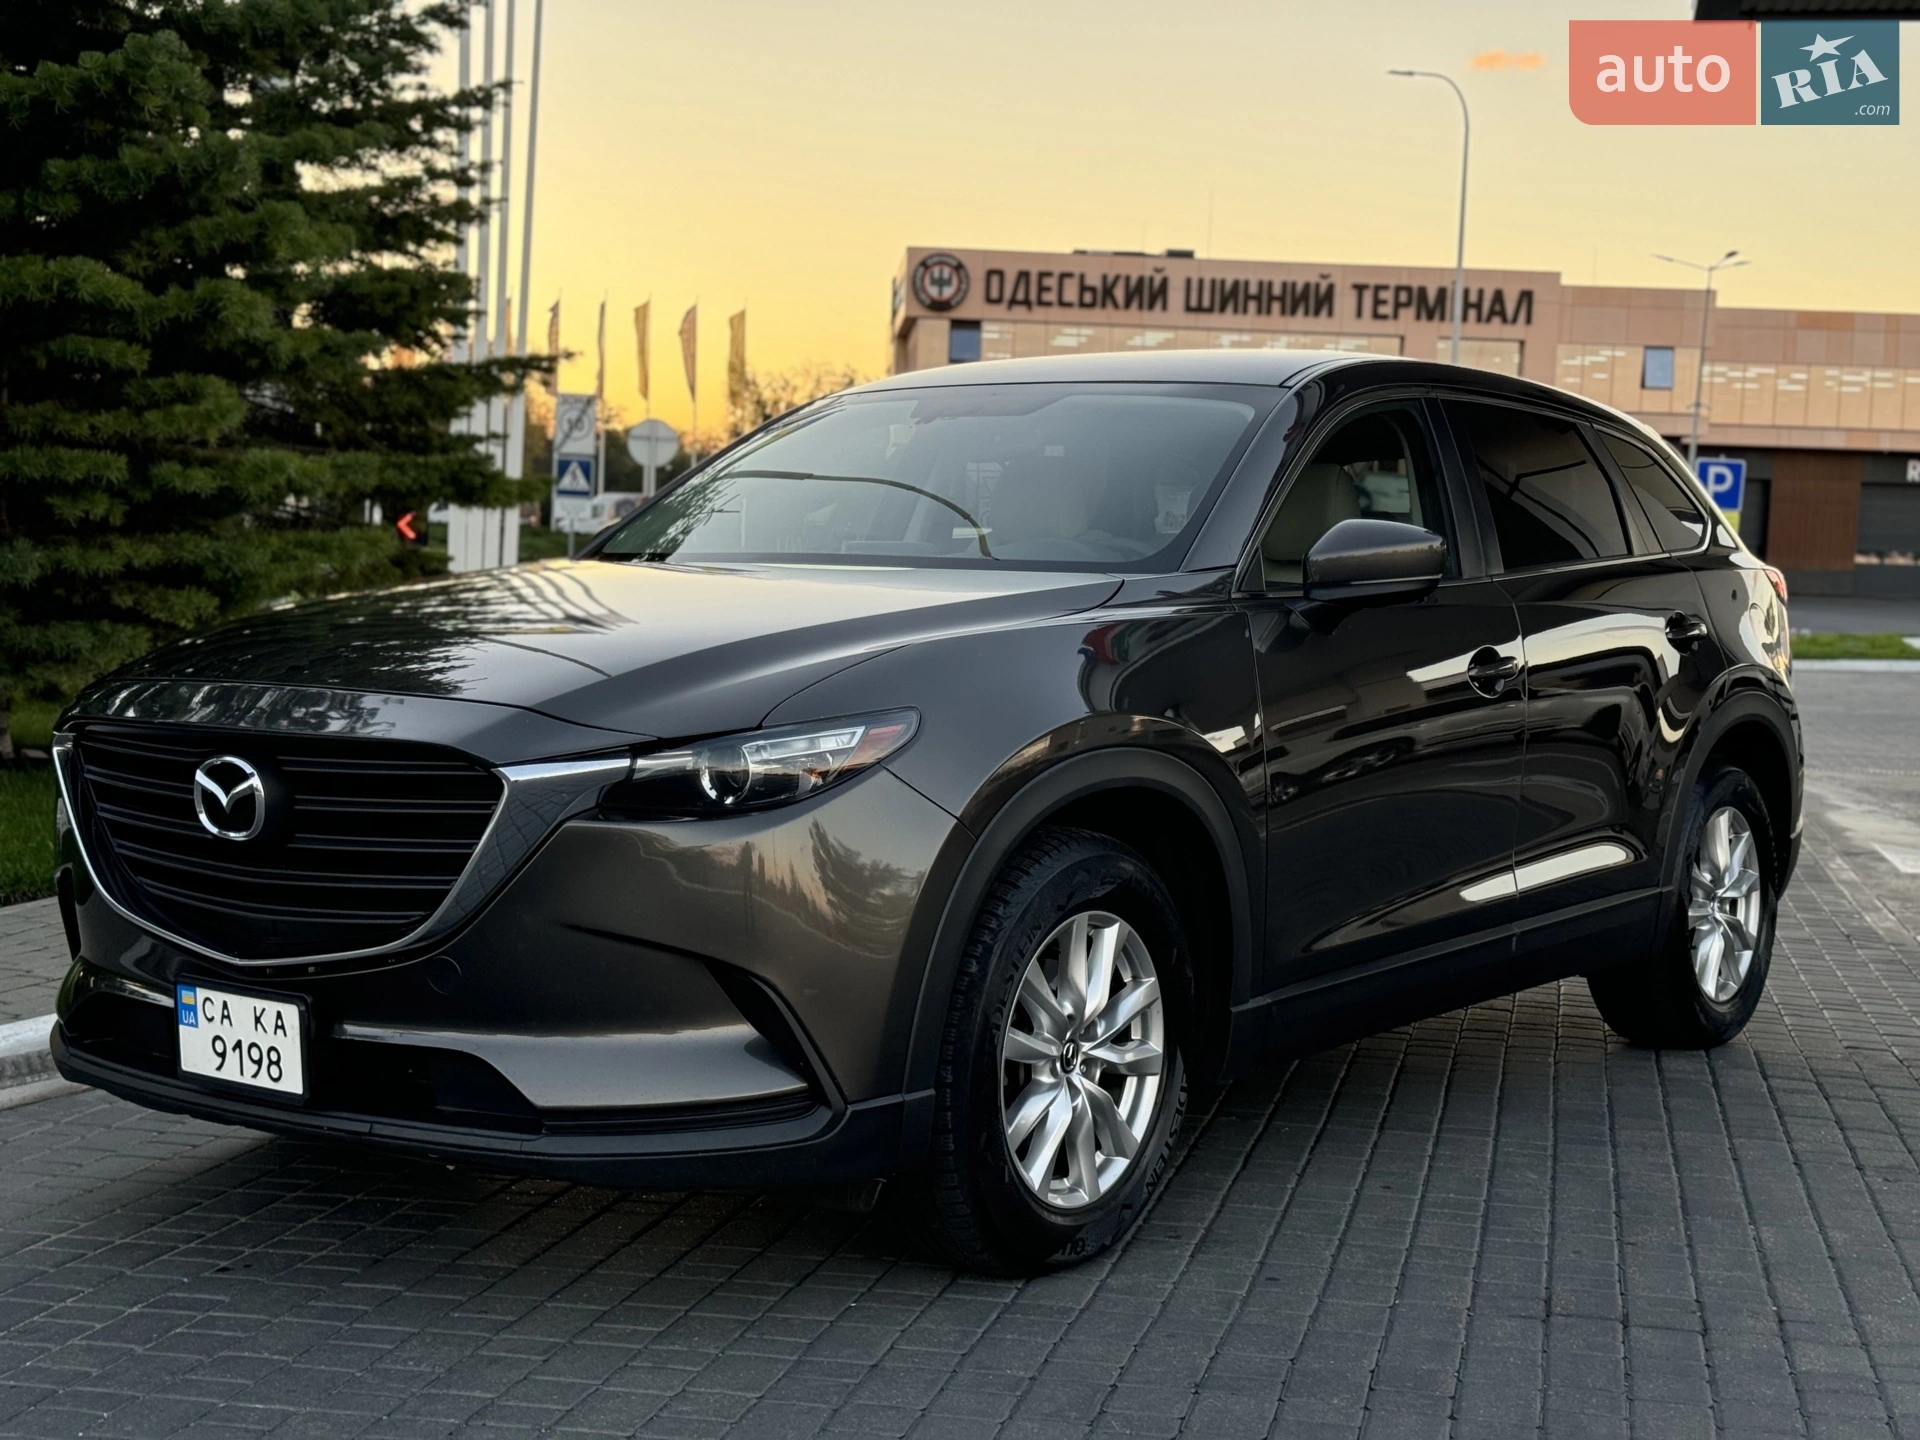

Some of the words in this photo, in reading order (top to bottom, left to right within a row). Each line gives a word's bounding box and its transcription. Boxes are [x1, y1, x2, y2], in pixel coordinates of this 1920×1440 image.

[984, 267, 1169, 312] ОДЕСЬКИЙ
[1184, 273, 1335, 318] ШИННИЙ
[1707, 464, 1734, 498] P
[182, 1009, 196, 1025] UA
[202, 996, 233, 1027] CA
[253, 1005, 288, 1038] KA
[211, 1034, 283, 1083] 9198
